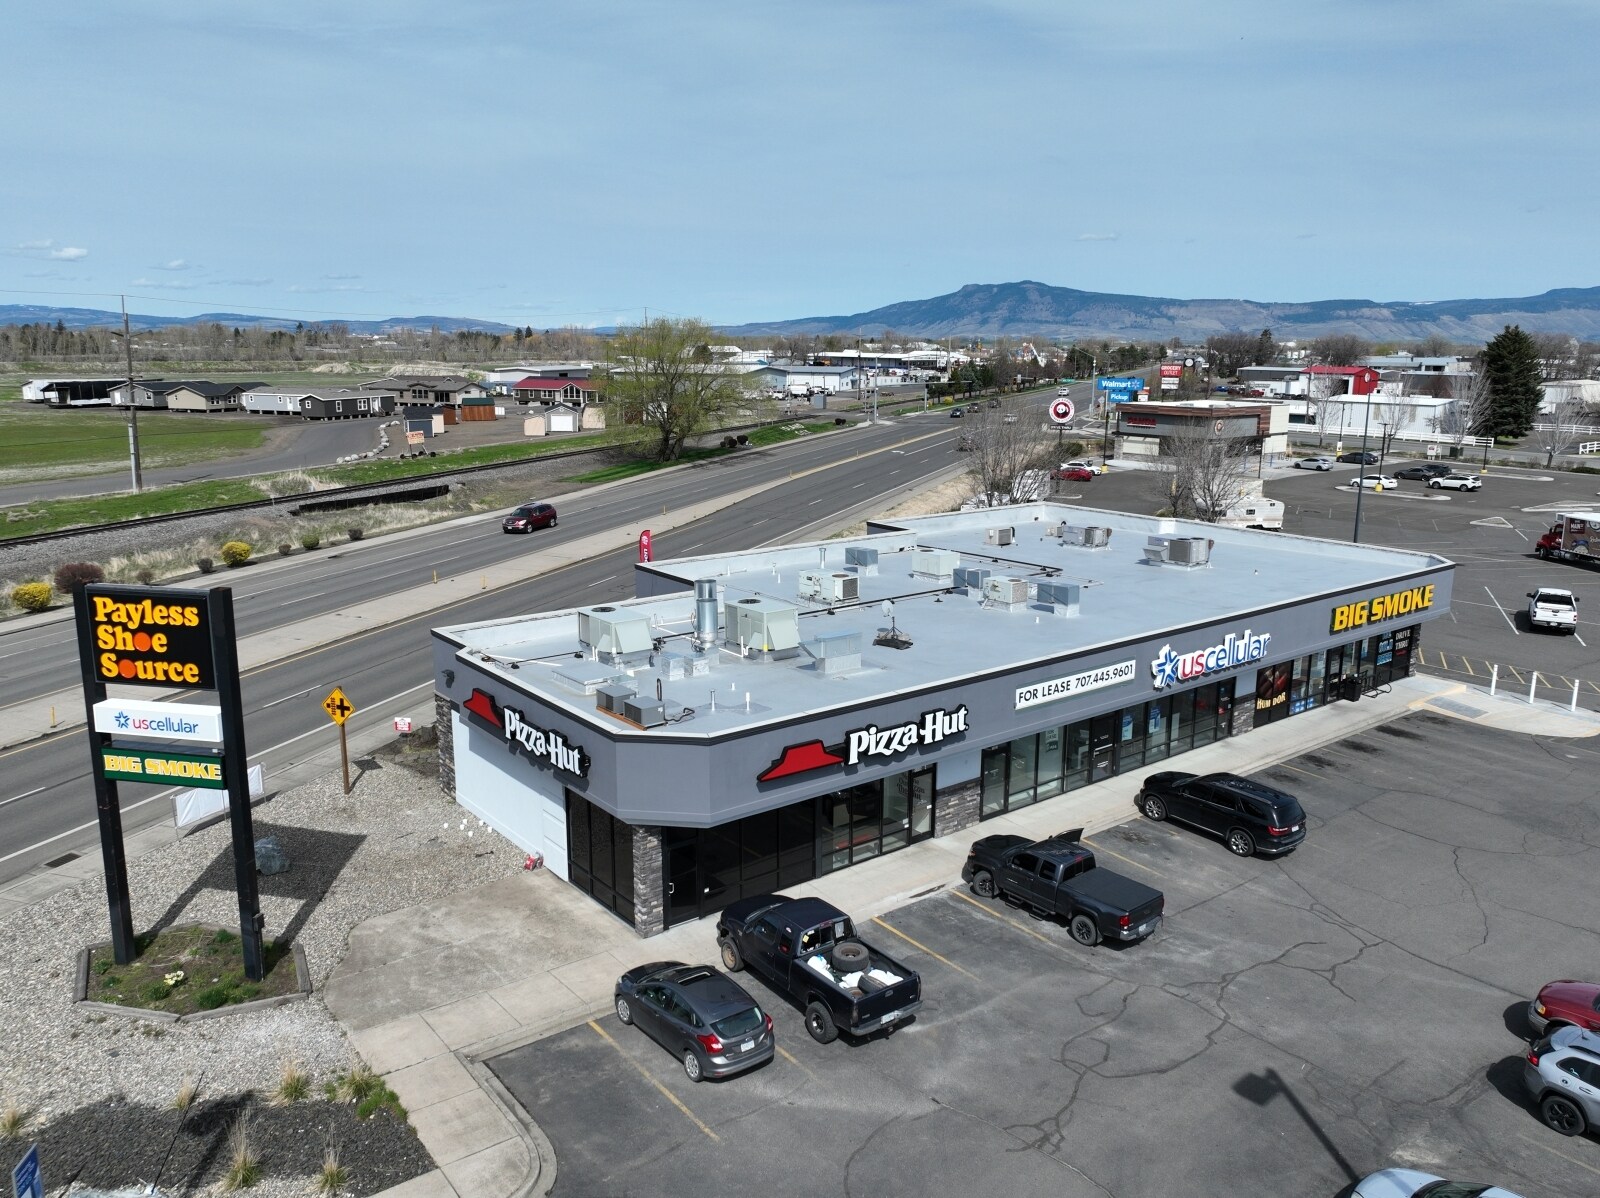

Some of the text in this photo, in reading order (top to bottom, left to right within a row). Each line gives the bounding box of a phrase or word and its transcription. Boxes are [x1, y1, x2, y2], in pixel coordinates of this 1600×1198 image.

[1101, 380, 1131, 388] Walmart
[93, 596, 199, 630] Payless
[1333, 583, 1435, 631] BIG SMOKE
[97, 624, 168, 653] Shoe
[100, 652, 199, 683] Source
[1181, 632, 1271, 678] uscellular
[1018, 663, 1134, 704] FOR LEASE 707.445.9601
[1256, 692, 1286, 709] HUMDOR
[132, 717, 199, 734] uscellular
[504, 707, 581, 775] Pizza Hut
[848, 706, 969, 765] Pizza Hut
[103, 754, 222, 781] BIG SMOKE
